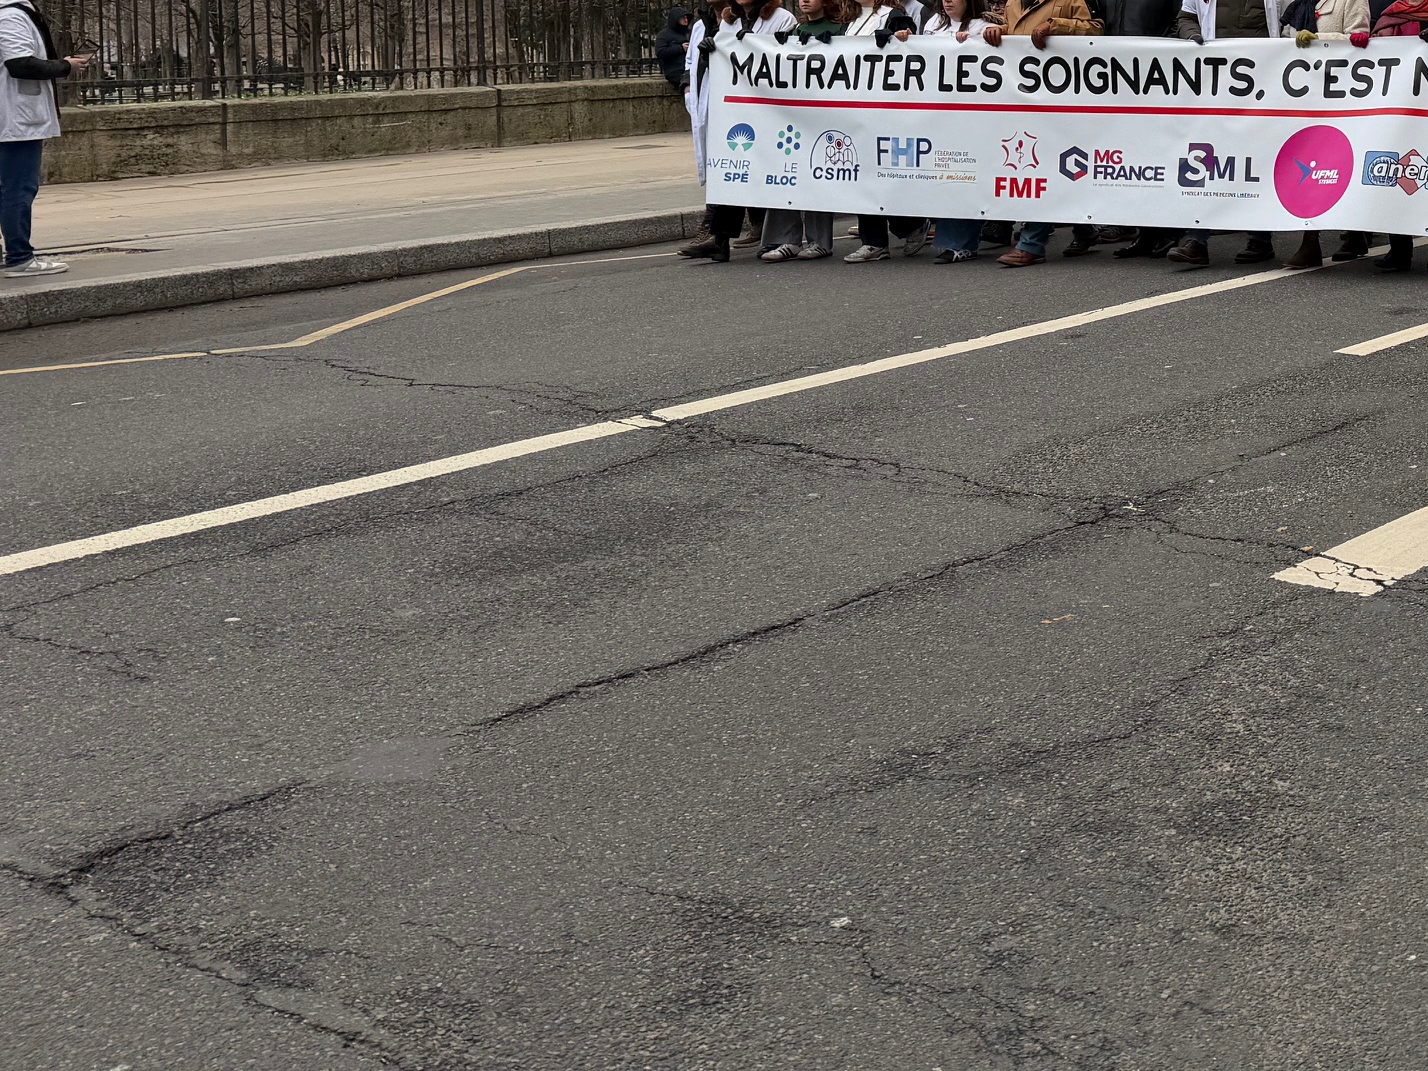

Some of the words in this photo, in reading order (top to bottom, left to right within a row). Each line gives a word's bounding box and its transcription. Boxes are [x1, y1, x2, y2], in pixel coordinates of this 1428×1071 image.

[730, 52, 925, 93] MALTRAITER
[939, 54, 1004, 93] LES
[1018, 56, 1265, 101] SOIGNANTS,
[1282, 57, 1401, 99] C'EST
[877, 137, 932, 167] FHP
[1094, 149, 1123, 165] MG
[707, 158, 750, 170] AVENIR
[784, 162, 798, 173] LE
[723, 171, 749, 183] SPÉ
[765, 175, 797, 186] BLOC
[812, 164, 860, 181] csmf
[1094, 165, 1165, 182] FRANCE
[1312, 169, 1339, 179] UFML
[994, 177, 1047, 199] FMF
